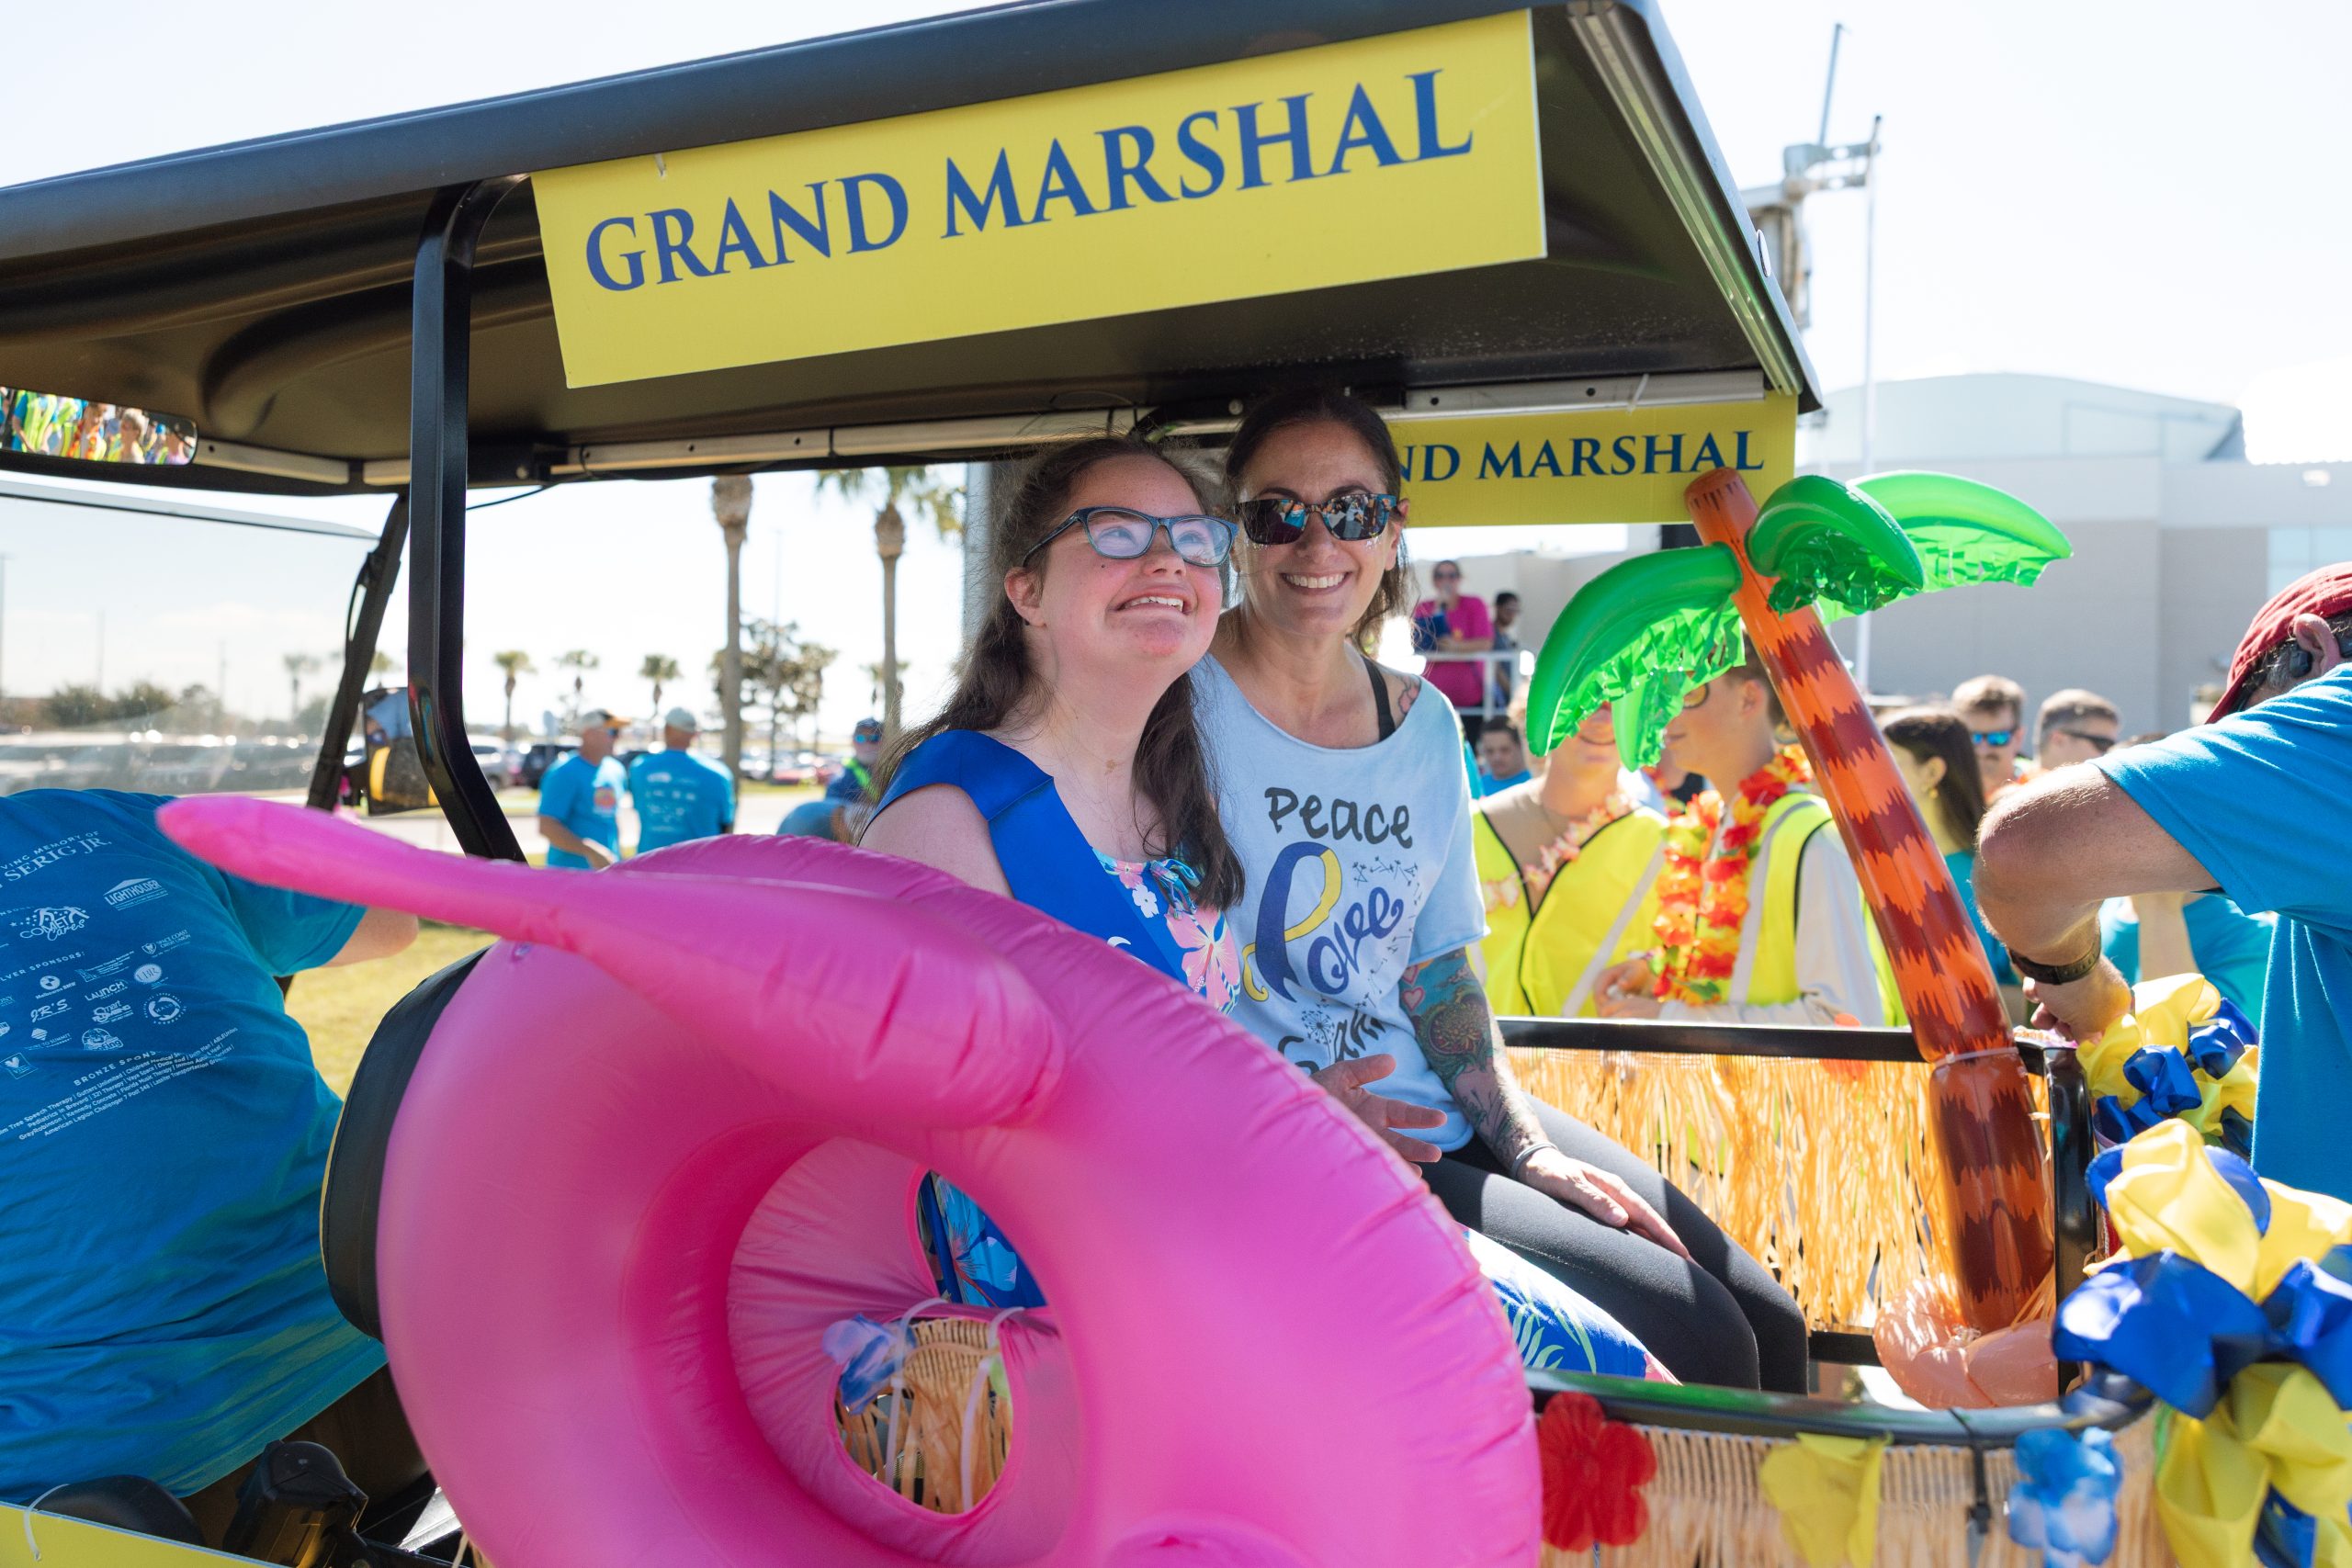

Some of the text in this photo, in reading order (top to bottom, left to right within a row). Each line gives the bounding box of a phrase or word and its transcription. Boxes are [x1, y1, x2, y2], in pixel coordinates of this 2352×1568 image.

[585, 69, 1474, 292] GRAND MARSHAL
[1476, 431, 1764, 479] MARSHAL
[1264, 787, 1413, 849] Peace
[33, 834, 81, 855] MEMORY
[4, 845, 77, 882] SERIG
[104, 879, 163, 906] LIGHTHOLDER
[47, 919, 85, 942] Cares
[74, 1063, 117, 1087] BRONZE
[24, 1108, 48, 1122] Speech
[48, 1096, 73, 1111] Therapy
[65, 1096, 88, 1111] Brevard
[44, 1120, 74, 1136] American
